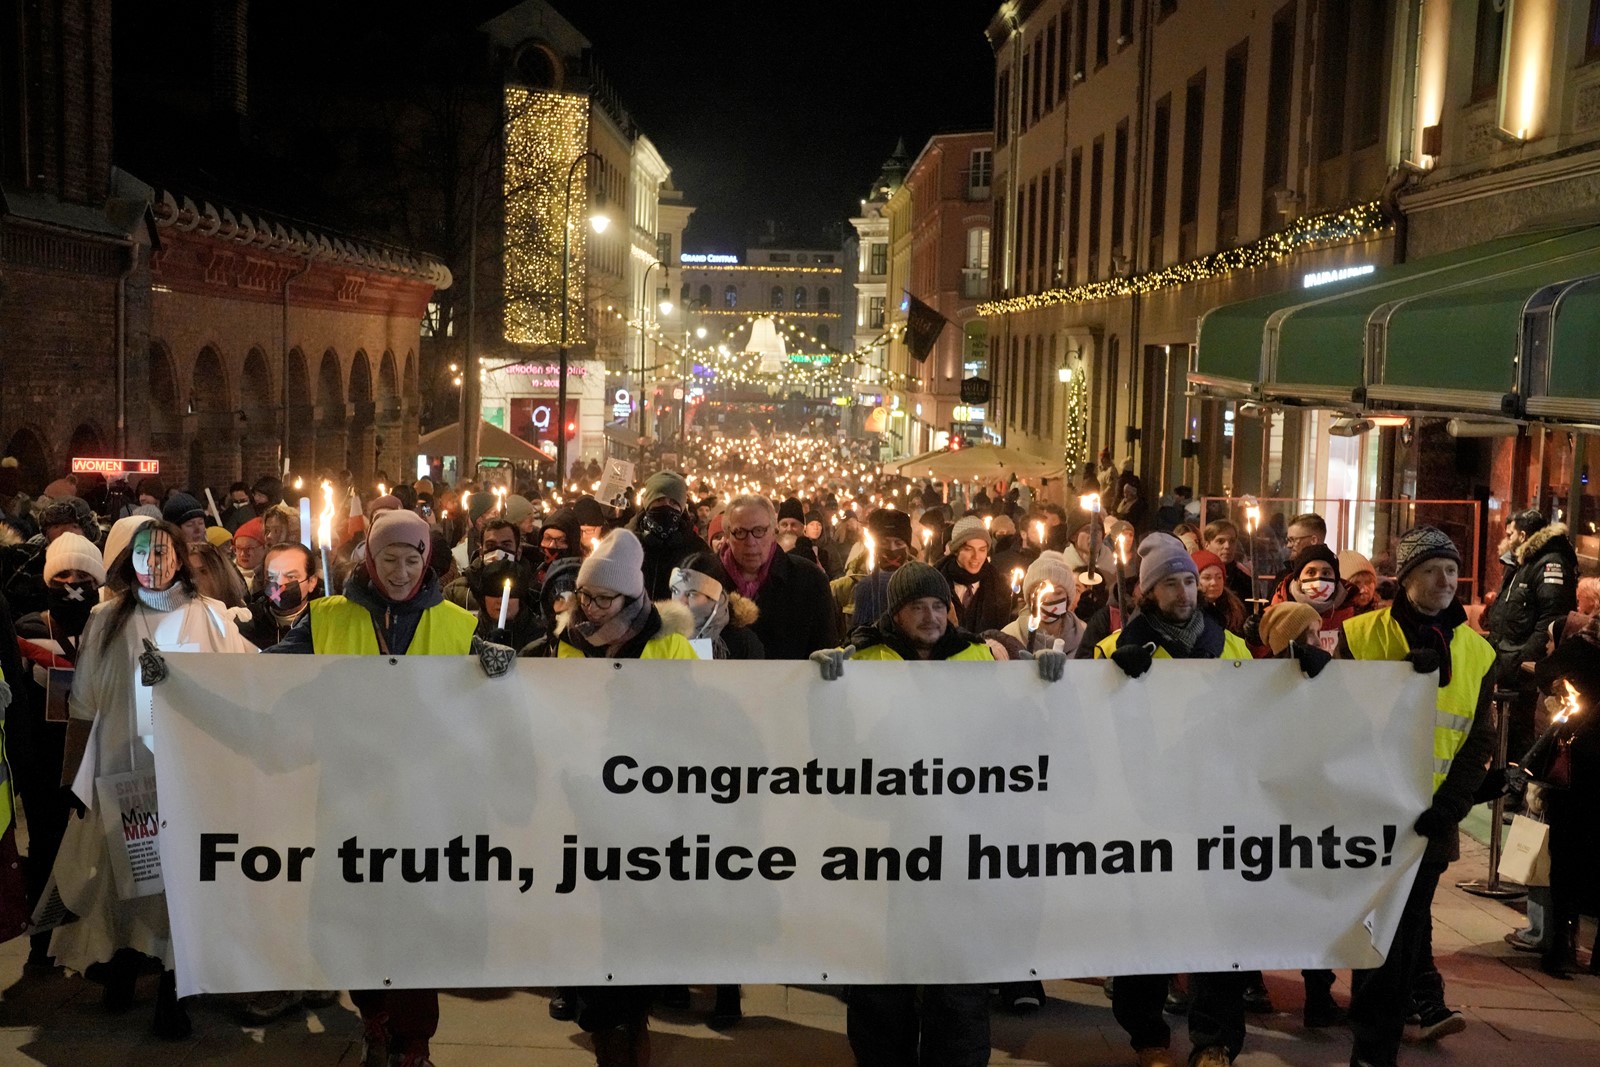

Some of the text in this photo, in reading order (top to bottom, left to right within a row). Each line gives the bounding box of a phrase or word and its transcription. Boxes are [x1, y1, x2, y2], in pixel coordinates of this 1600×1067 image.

[680, 253, 738, 263] GRAND CENTRAL
[546, 364, 586, 377] shoping
[74, 460, 122, 471] WOMEN
[602, 754, 1050, 806] Congratulations!
[124, 822, 159, 841] MAJ
[199, 823, 1397, 896] For truth, justice and human rights!
